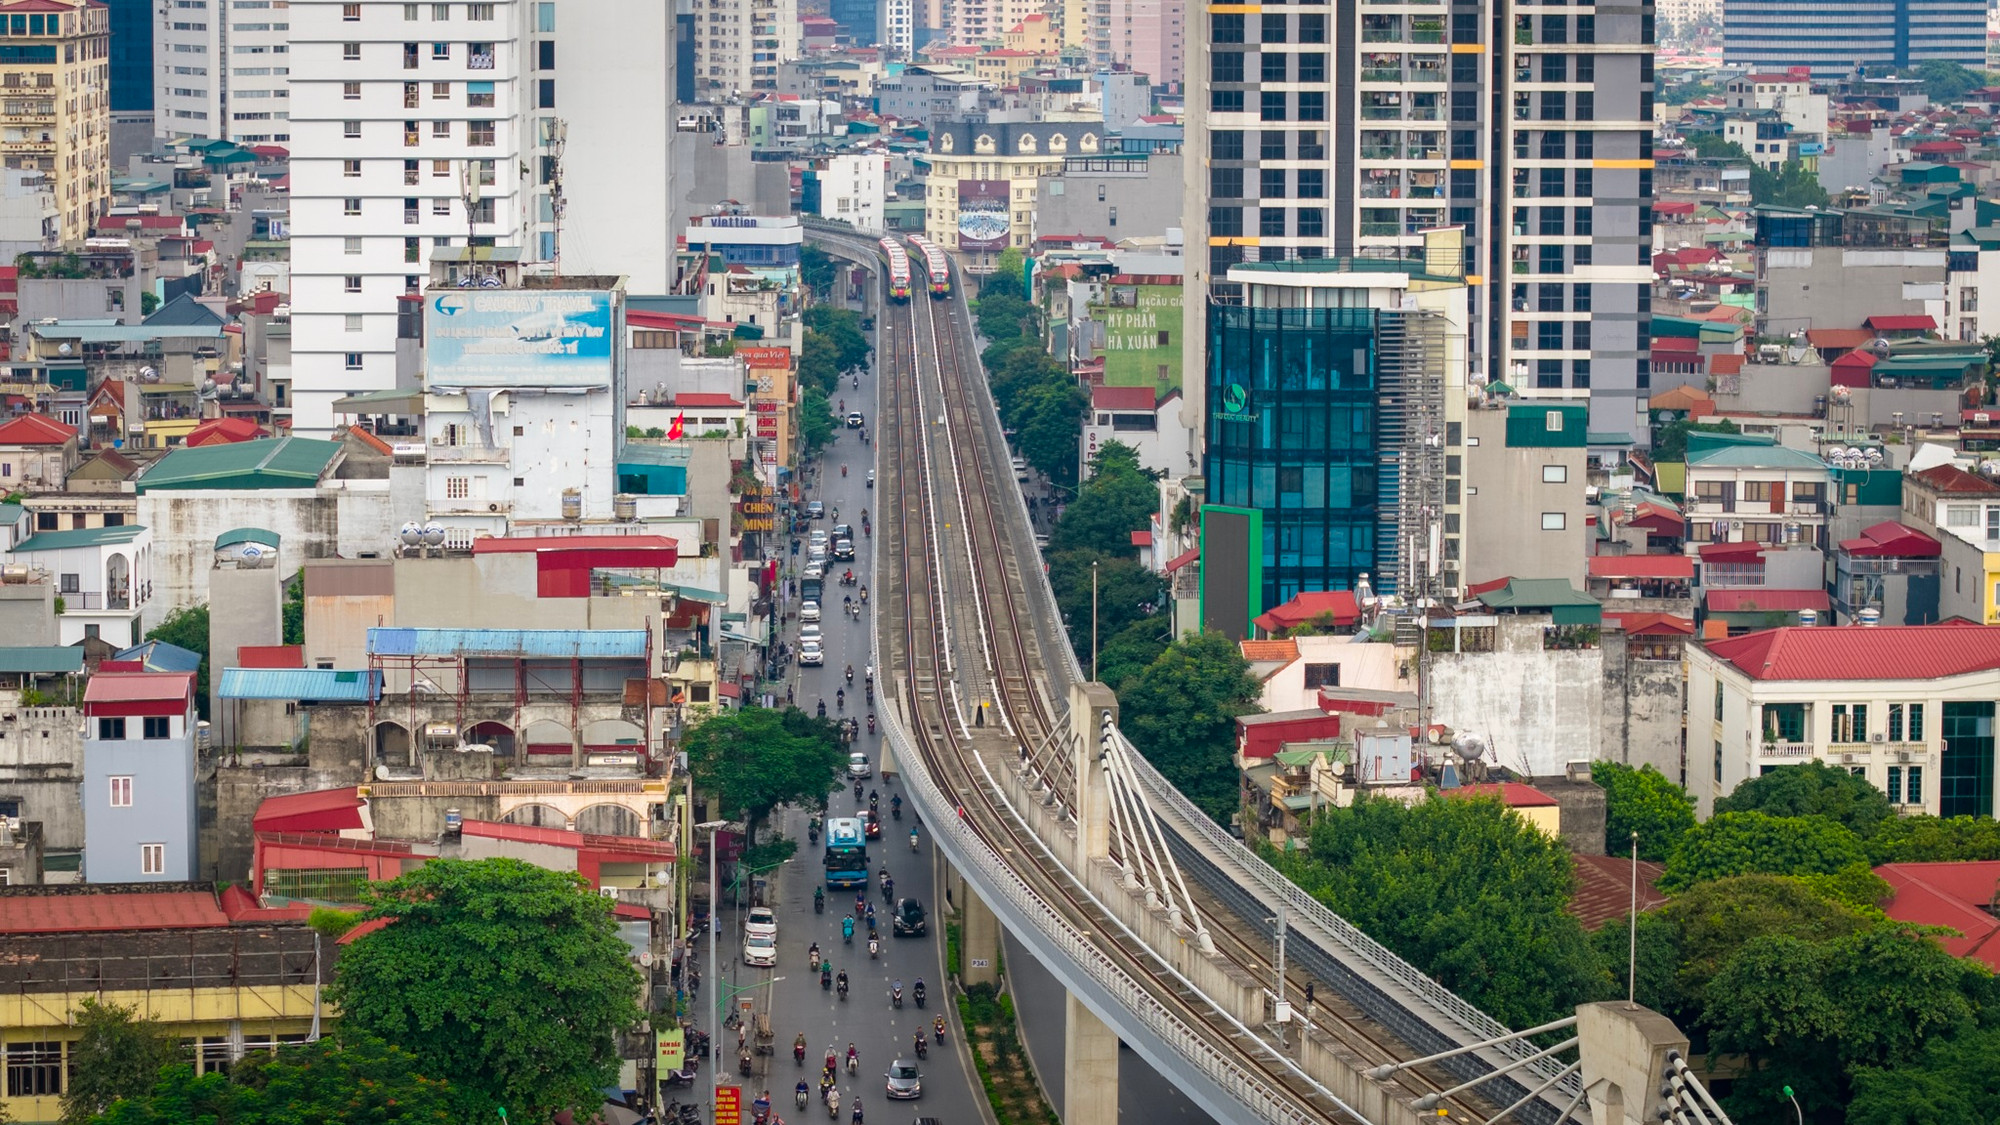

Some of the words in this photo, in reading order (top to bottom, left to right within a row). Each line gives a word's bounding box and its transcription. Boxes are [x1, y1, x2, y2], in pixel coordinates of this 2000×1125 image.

[711, 217, 757, 228] viettien
[541, 295, 595, 312] TRAVEL
[1127, 330, 1157, 350] XUÂN
[743, 518, 773, 531] MINH
